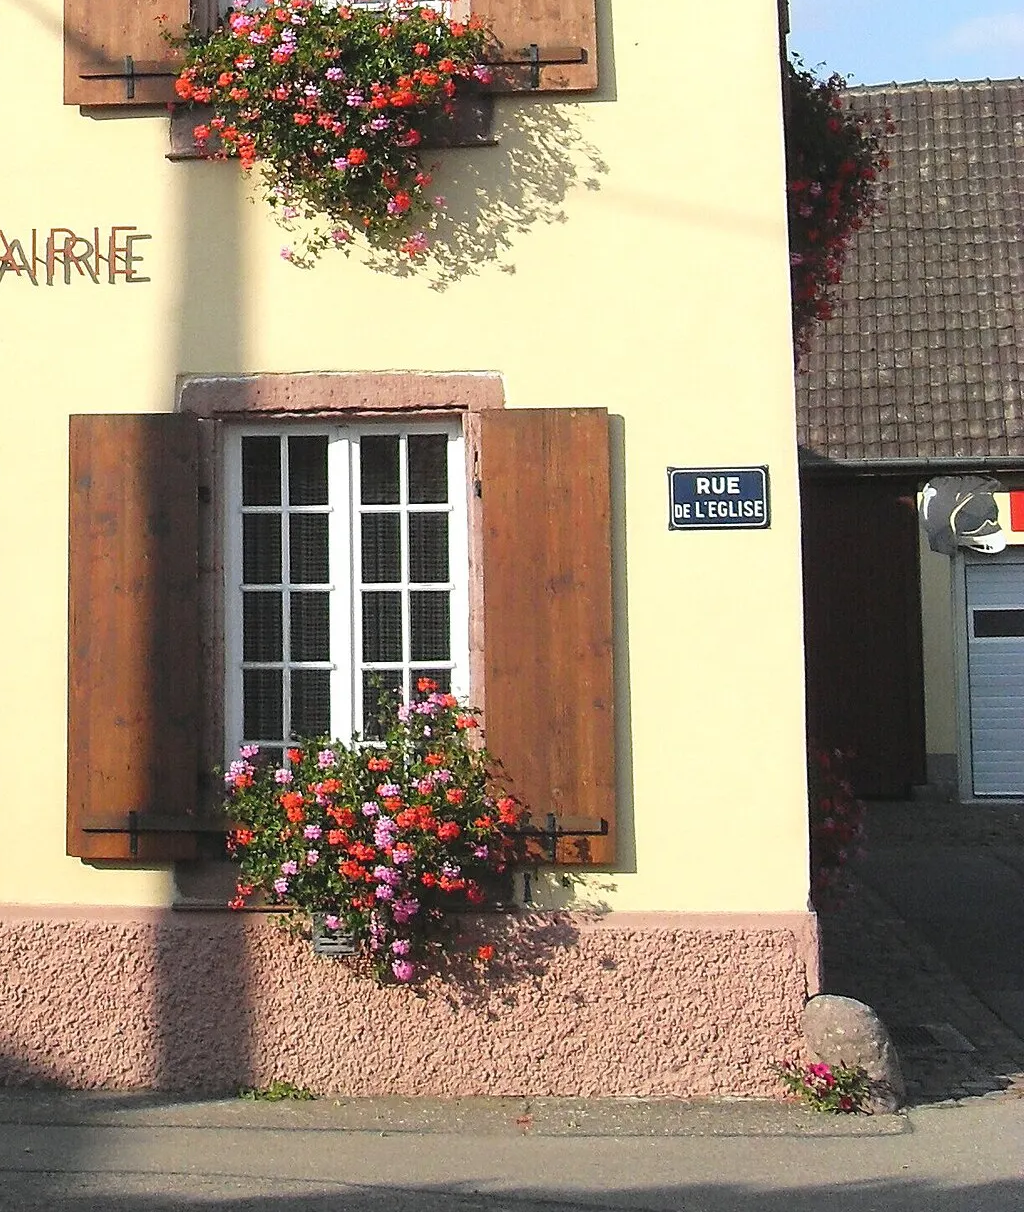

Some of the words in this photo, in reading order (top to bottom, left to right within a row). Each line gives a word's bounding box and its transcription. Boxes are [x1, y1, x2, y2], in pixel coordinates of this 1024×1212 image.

[696, 476, 741, 495] RUE
[674, 503, 691, 519] DE
[695, 500, 764, 518] L'EGLISE
